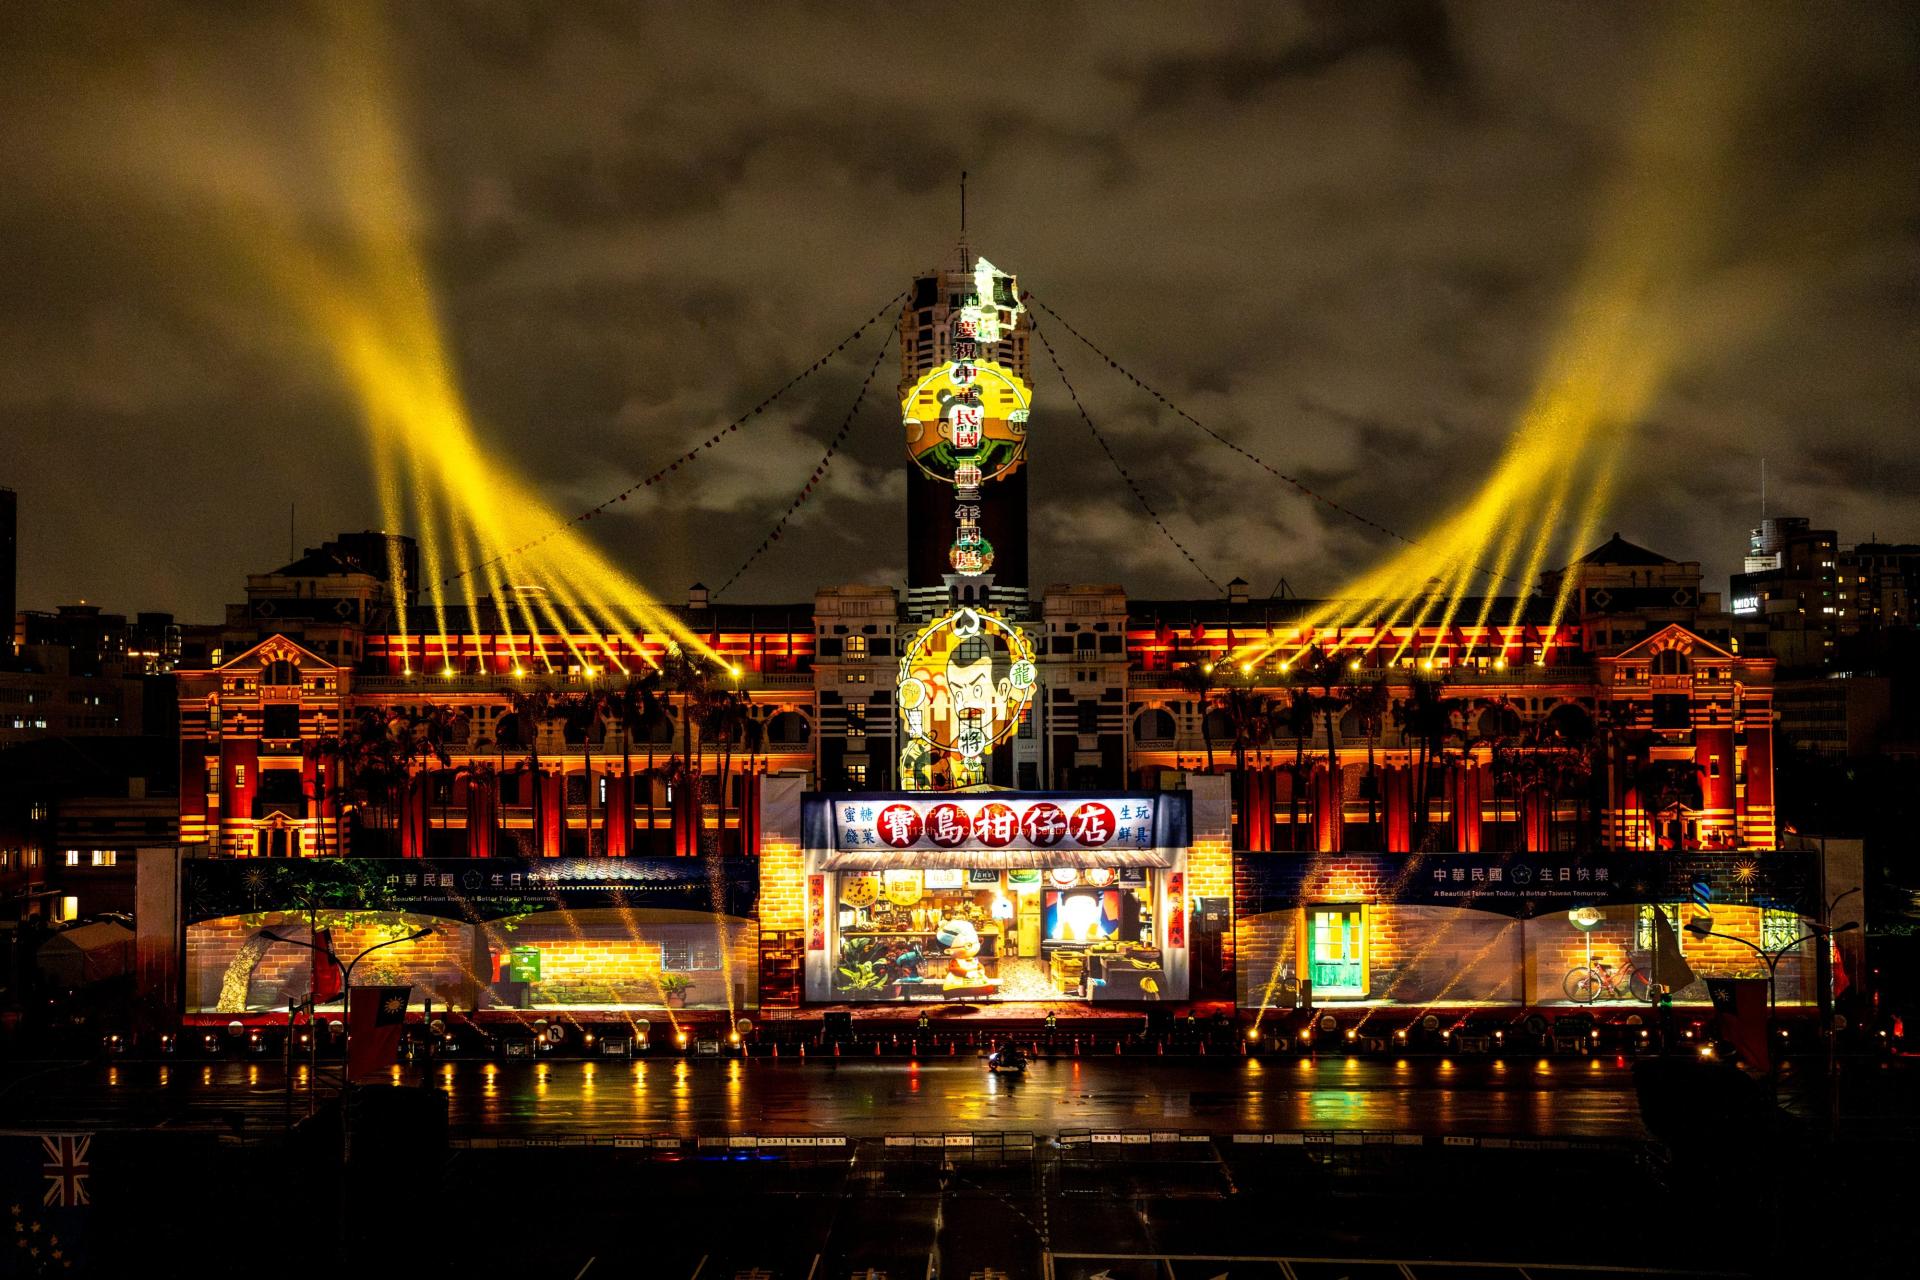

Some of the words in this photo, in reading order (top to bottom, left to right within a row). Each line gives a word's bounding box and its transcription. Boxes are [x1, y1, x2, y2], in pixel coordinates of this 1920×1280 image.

[1012, 663, 1034, 686] 龍
[961, 731, 982, 754] 將
[884, 804, 1108, 845] 寶島柑仔店
[386, 873, 455, 888] 中華民國
[491, 873, 560, 887] 生日快樂
[1433, 867, 1503, 883] 中華民國
[1540, 867, 1609, 882] 生日快樂
